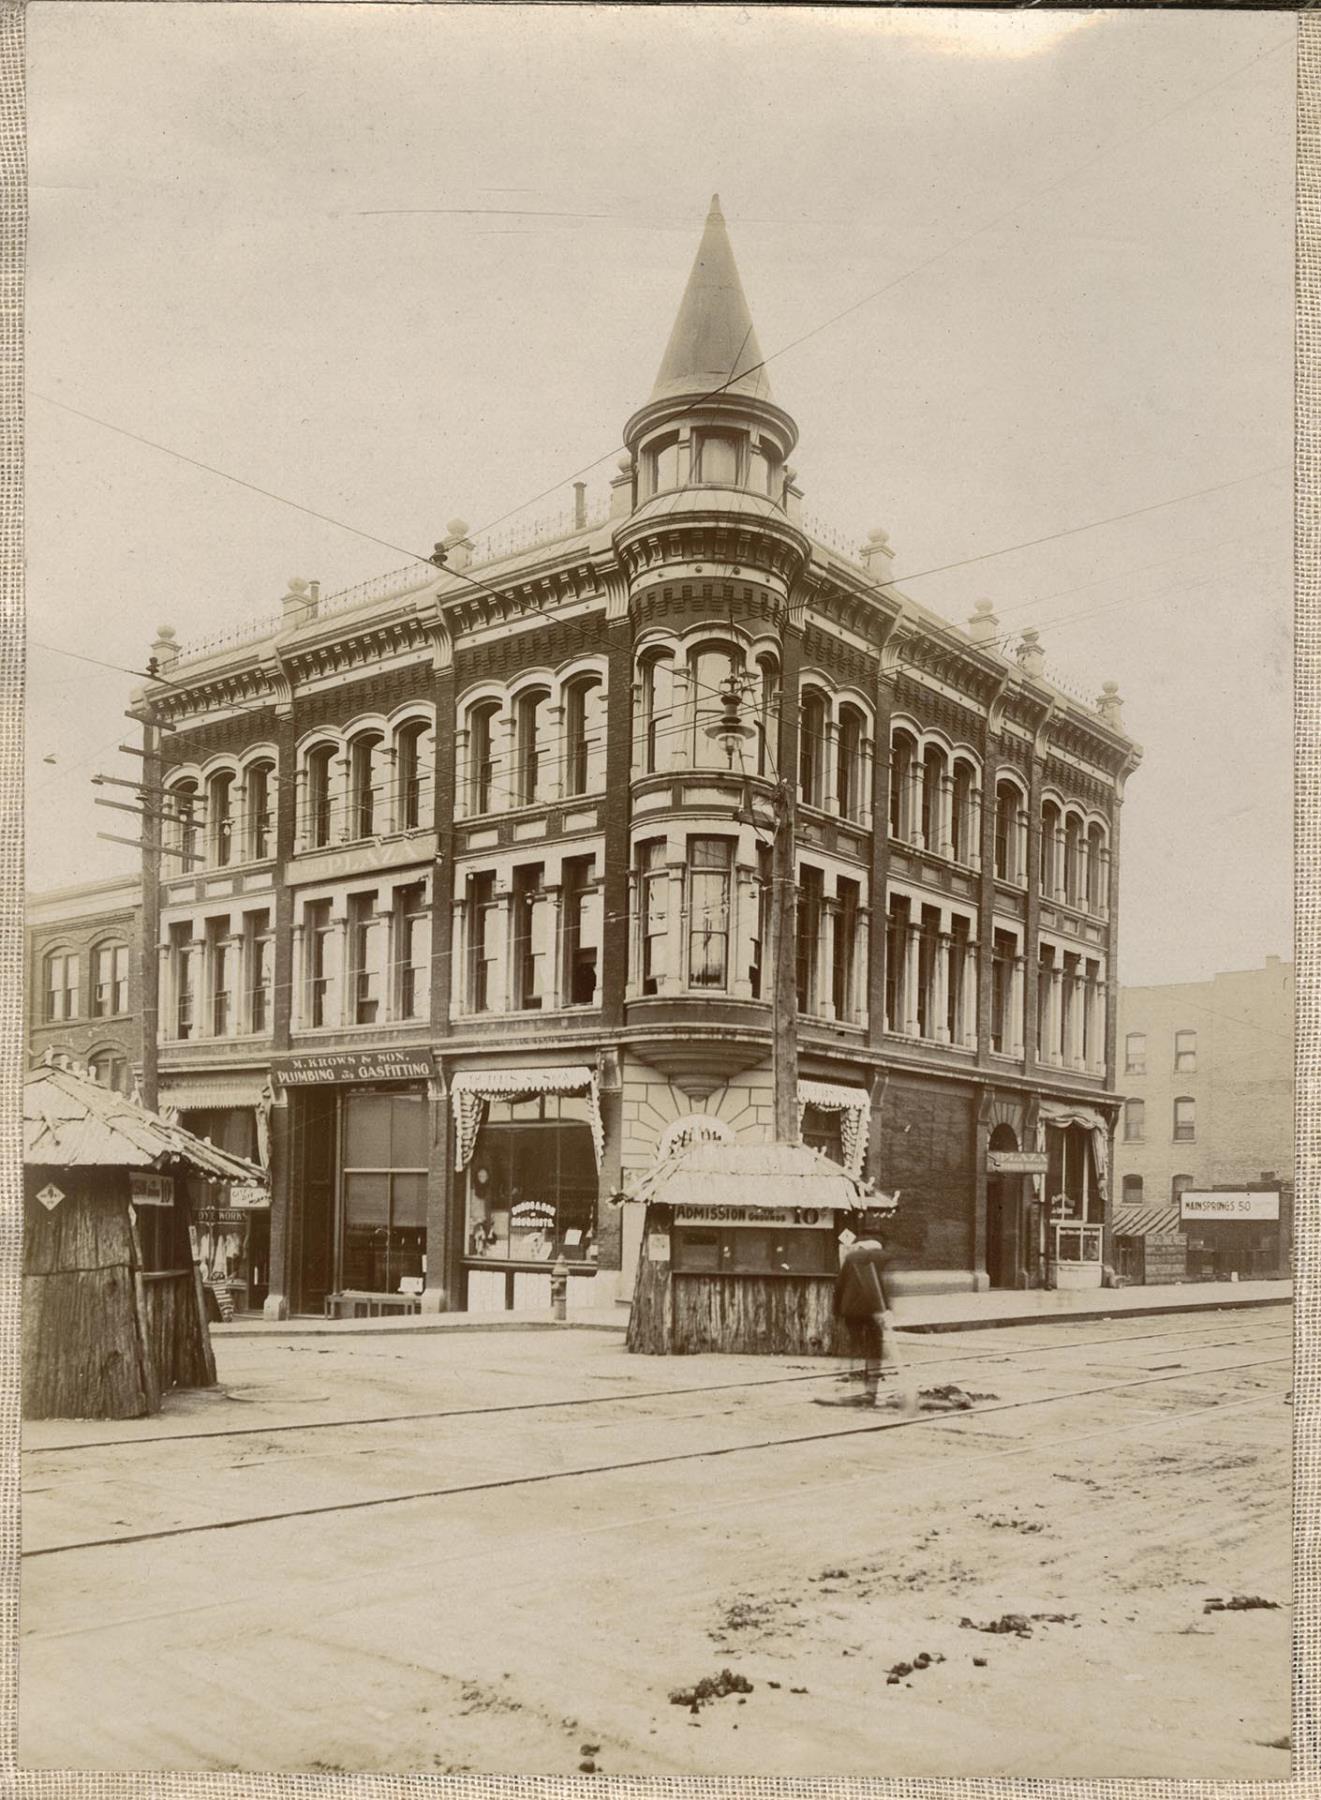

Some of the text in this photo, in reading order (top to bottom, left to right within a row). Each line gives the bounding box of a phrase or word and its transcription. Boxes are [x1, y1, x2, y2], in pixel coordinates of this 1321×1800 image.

[328, 843, 418, 874] PLAZA
[277, 1069, 335, 1083] PLUMBING
[358, 1063, 429, 1078] GASFITTING
[676, 1206, 746, 1222] ADMISSION
